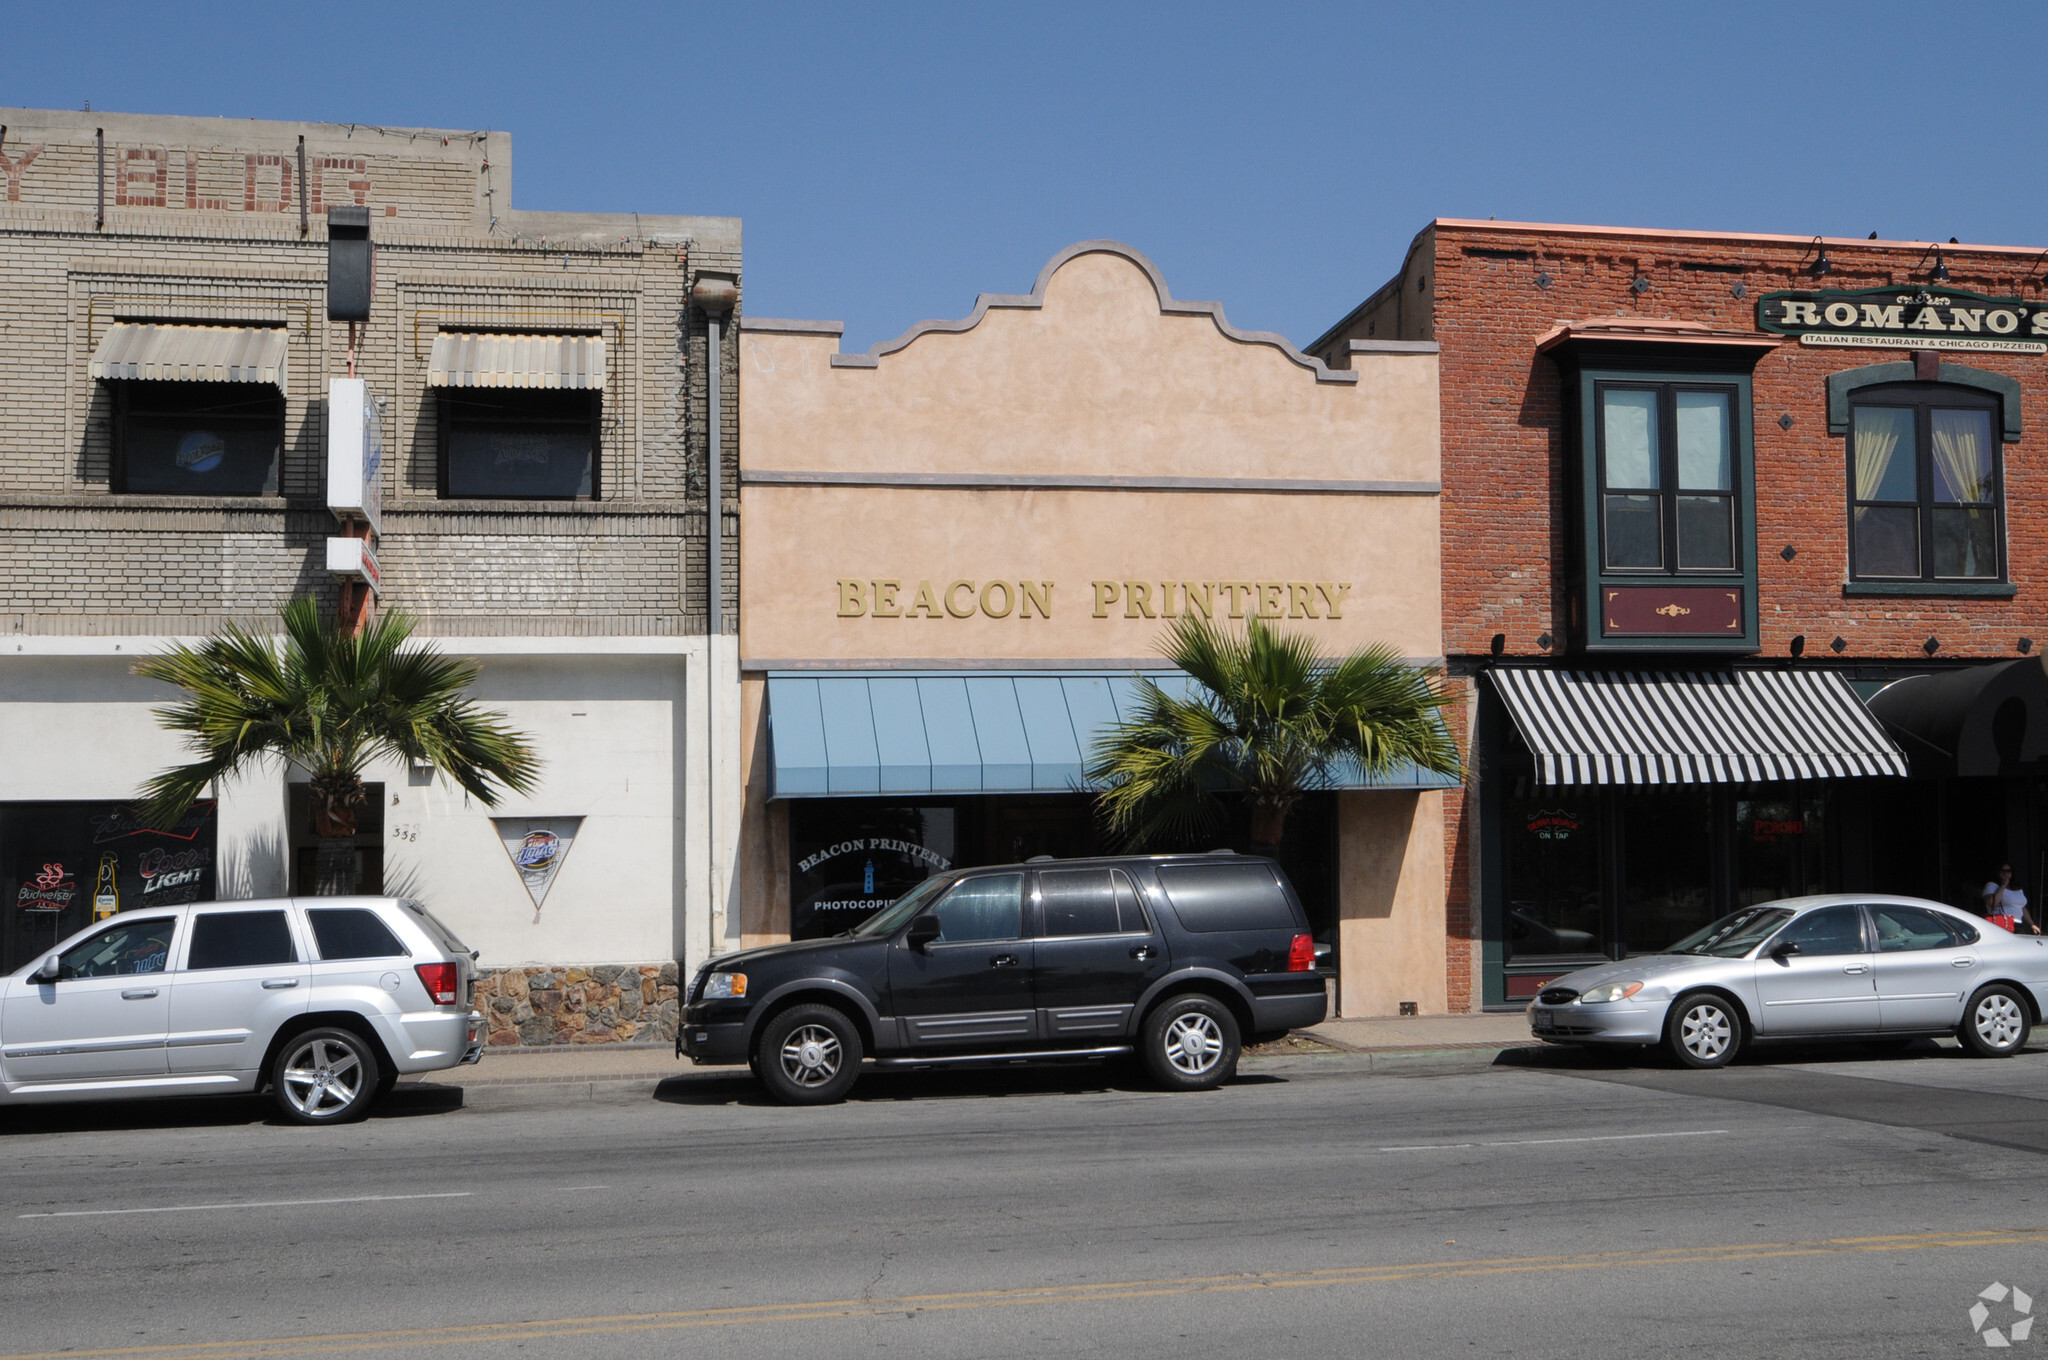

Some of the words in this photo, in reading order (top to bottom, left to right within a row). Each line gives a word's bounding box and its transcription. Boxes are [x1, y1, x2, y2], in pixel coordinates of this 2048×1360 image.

[1804, 334, 1849, 344] ITALIAN
[1851, 337, 1925, 347] RESTAURANT
[1928, 339, 1935, 347] &
[1938, 340, 1989, 349] CHICAGO
[1991, 342, 2043, 351] PIZZERIA
[836, 579, 1055, 618] BEACON
[1092, 580, 1352, 619] PRINTERY
[1539, 832, 1551, 840] ON
[1555, 832, 1569, 840] TAP
[139, 847, 211, 878] Coors
[798, 839, 865, 873] BEACON
[869, 838, 952, 871] PRINTERY
[18, 887, 76, 901] Budweiser
[143, 867, 207, 894] LIGHT
